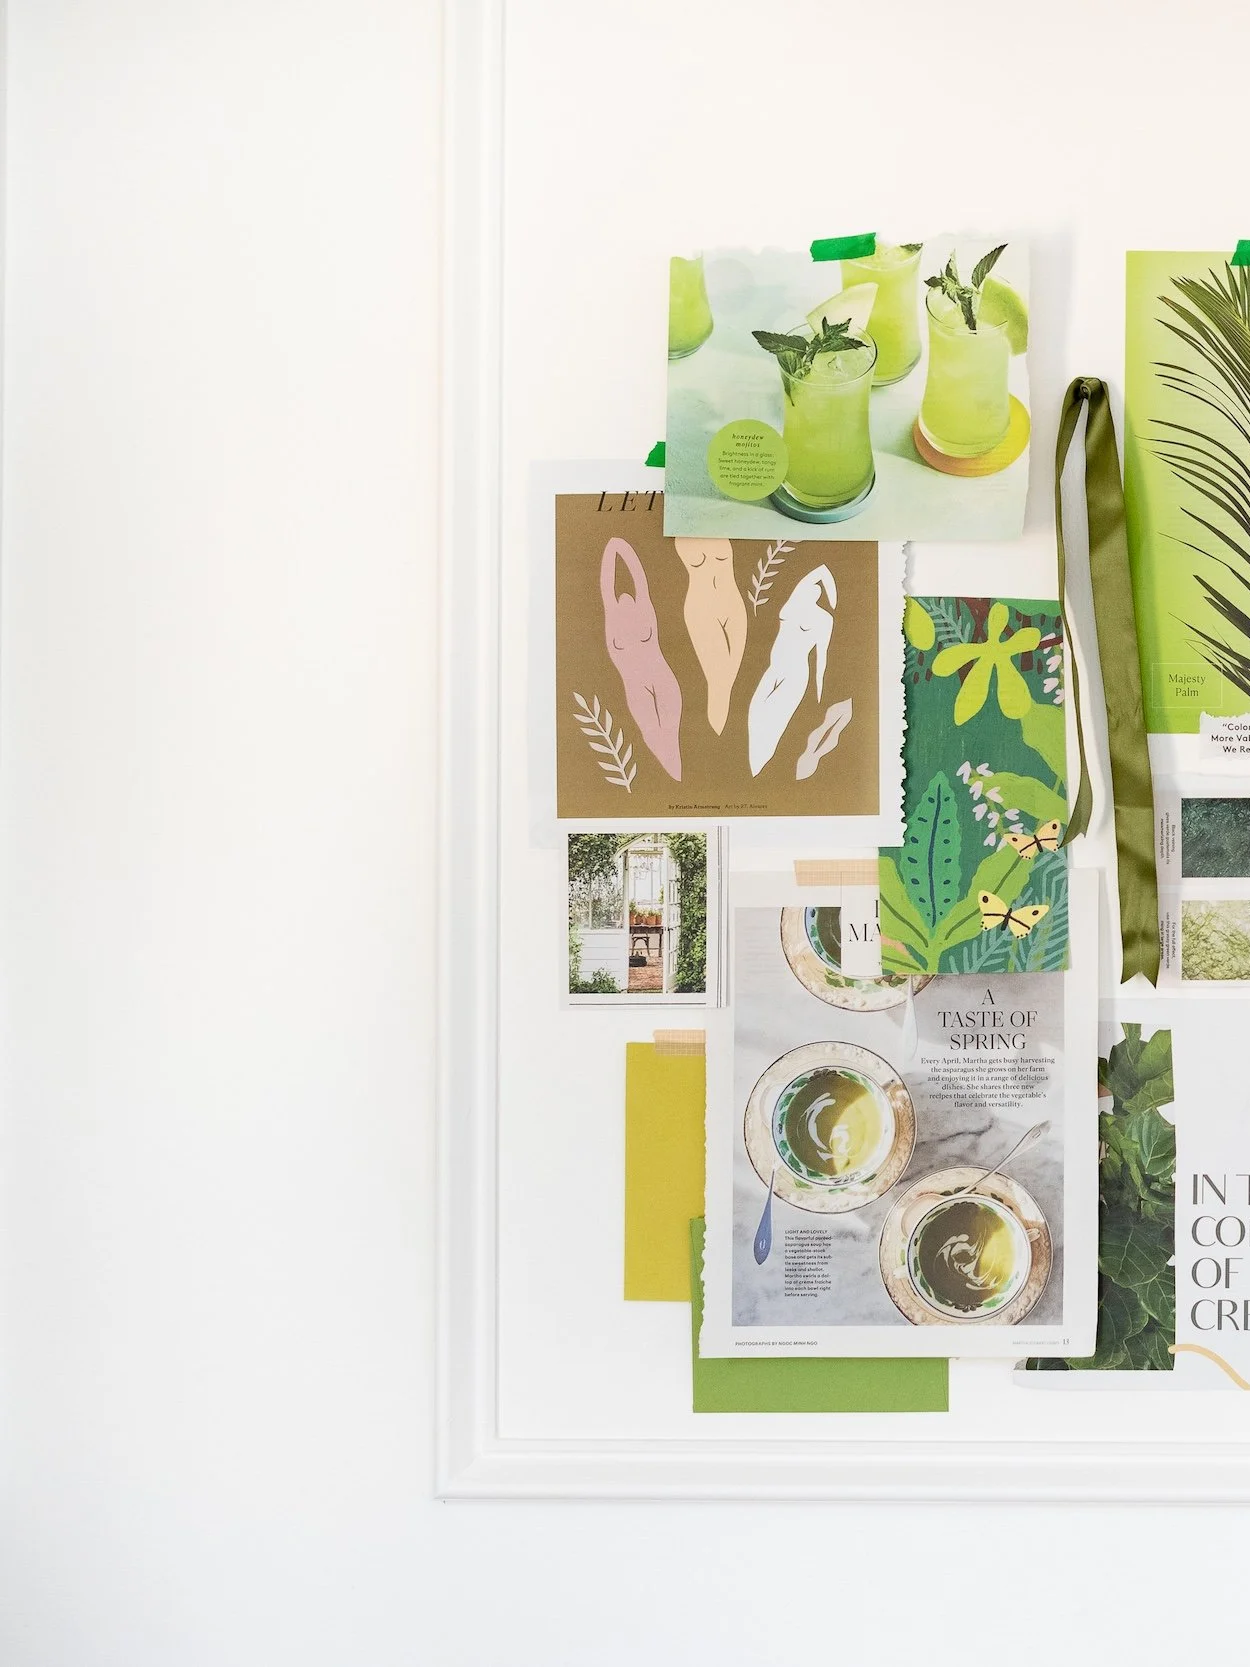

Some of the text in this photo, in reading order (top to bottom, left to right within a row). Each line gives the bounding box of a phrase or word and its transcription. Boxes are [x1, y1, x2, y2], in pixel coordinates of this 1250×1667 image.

[1168, 674, 1206, 685] Majesty
[1175, 688, 1199, 696] Palm
[981, 988, 995, 1005] A
[938, 1011, 1038, 1028] TASTE OF
[949, 1033, 1026, 1050] SPRING
[1192, 1174, 1227, 1205] IN
[1191, 1257, 1244, 1289] OF
